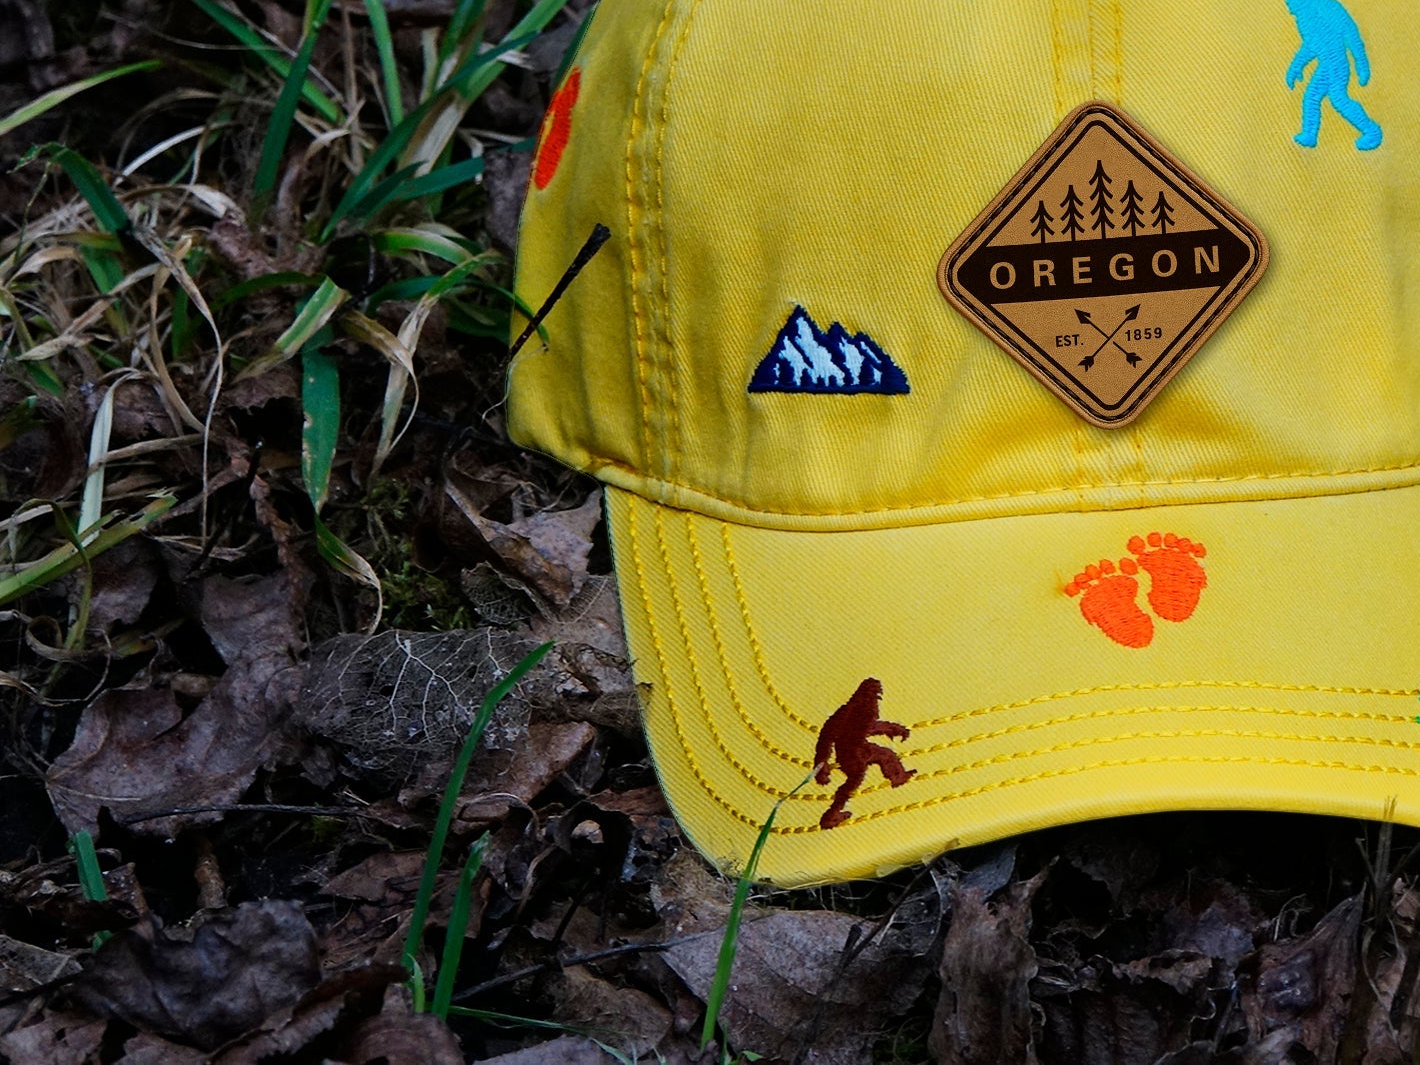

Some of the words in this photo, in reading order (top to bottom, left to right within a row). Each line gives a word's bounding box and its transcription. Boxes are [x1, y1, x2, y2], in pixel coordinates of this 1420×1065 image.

[989, 245, 1220, 290] OREGON
[1055, 334, 1084, 348] EST.
[1124, 327, 1163, 342] 1859
